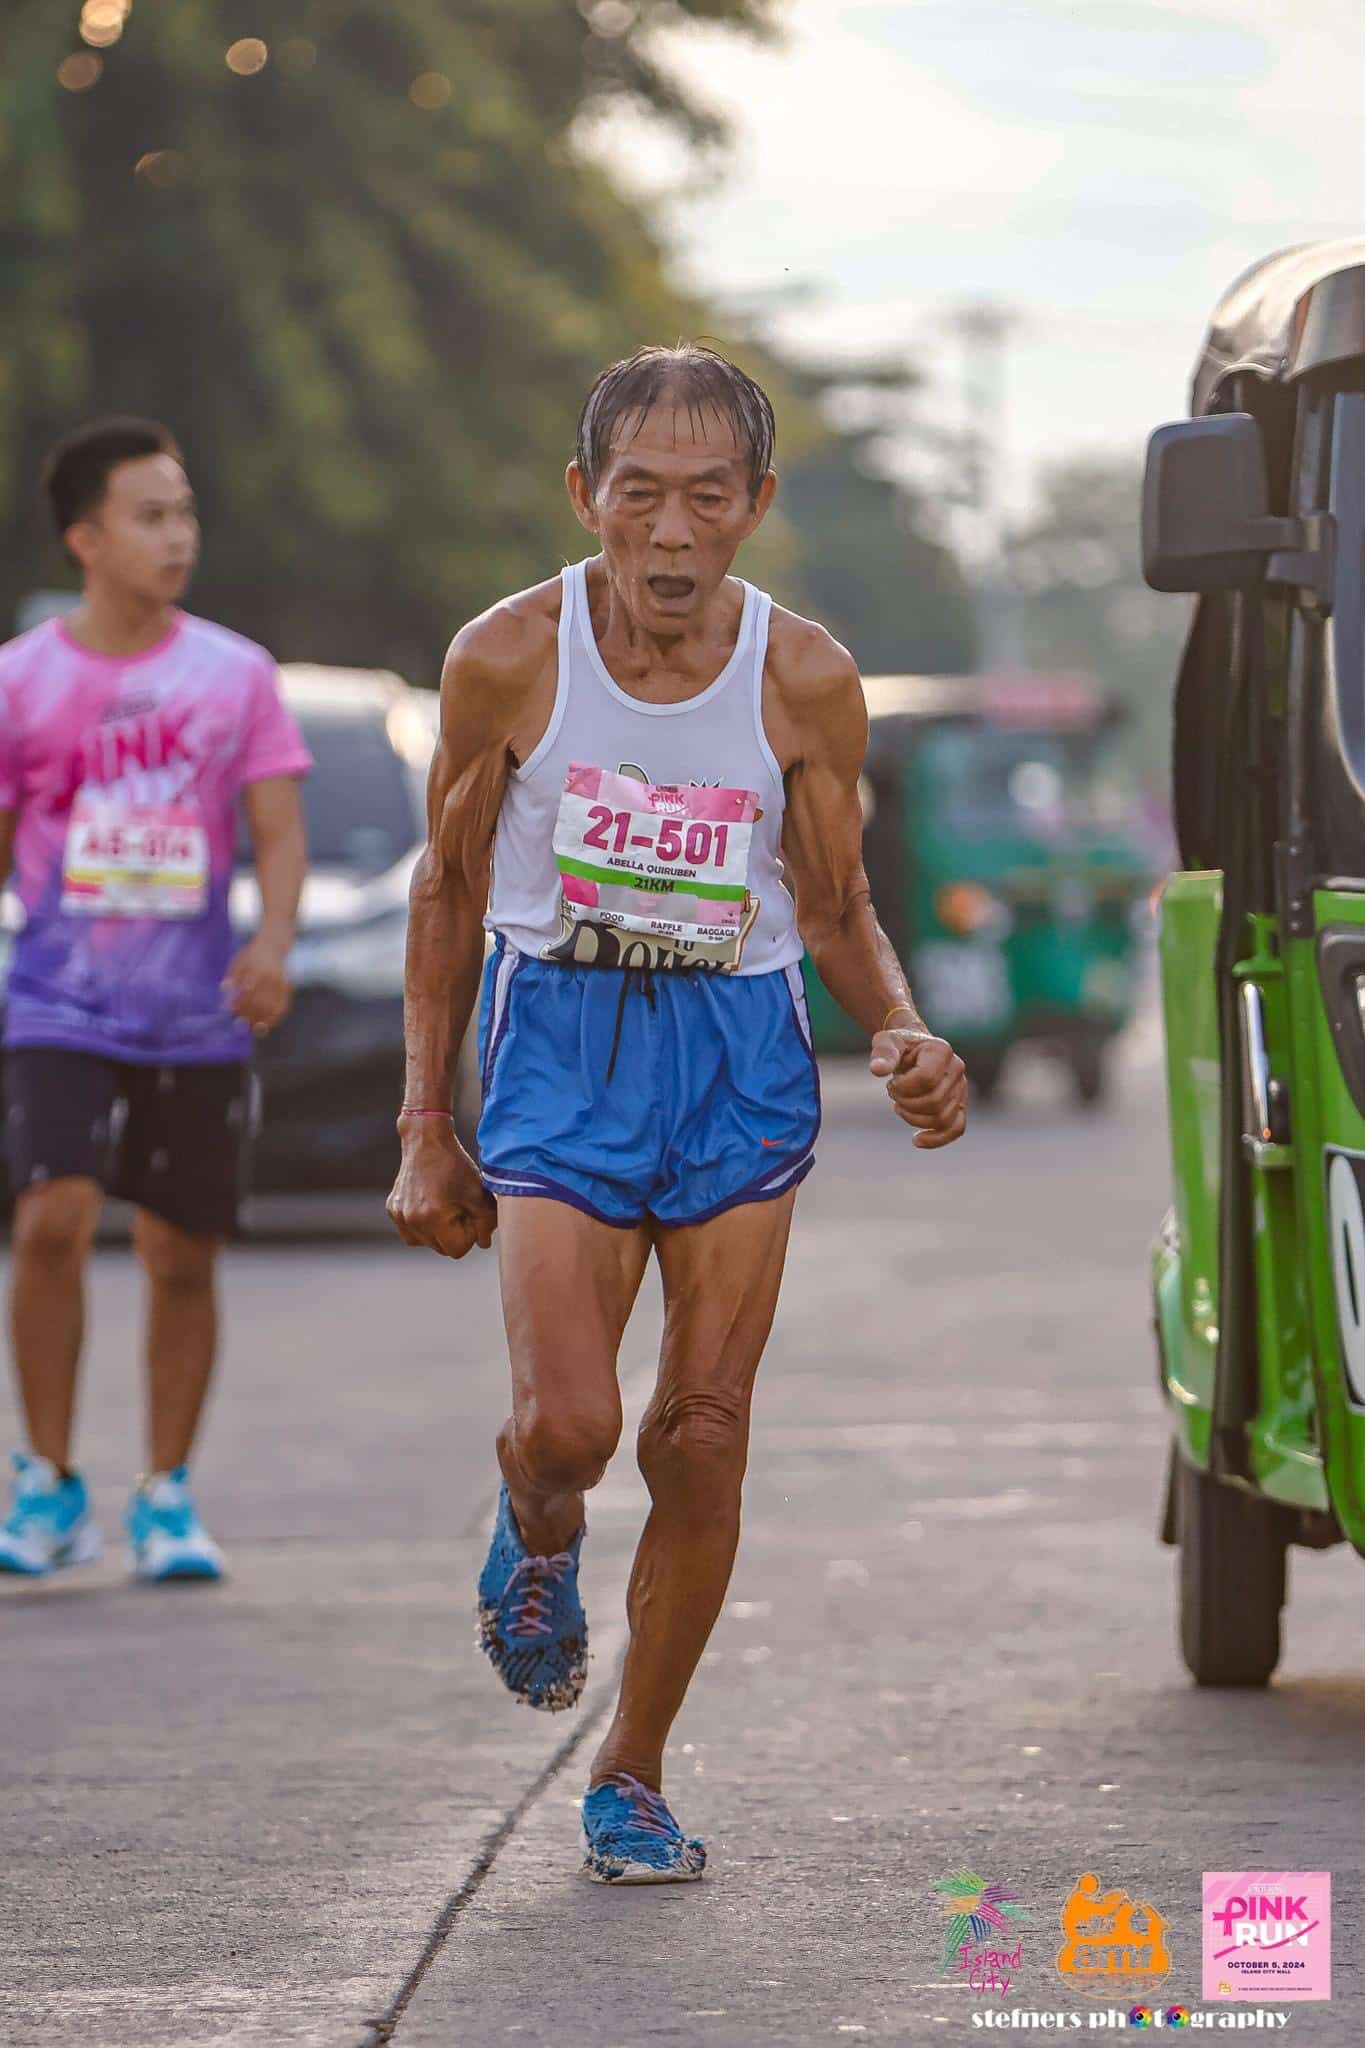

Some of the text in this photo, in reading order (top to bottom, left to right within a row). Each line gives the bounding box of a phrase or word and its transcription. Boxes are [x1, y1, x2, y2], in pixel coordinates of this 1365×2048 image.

[582, 805, 729, 868] 21-501
[606, 857, 697, 878] ABELLA QUIRUBEN
[633, 877, 676, 892] 21KM
[599, 911, 625, 922] FOOD
[650, 920, 683, 932] RAFFLE
[696, 927, 736, 937] BAGGAGE
